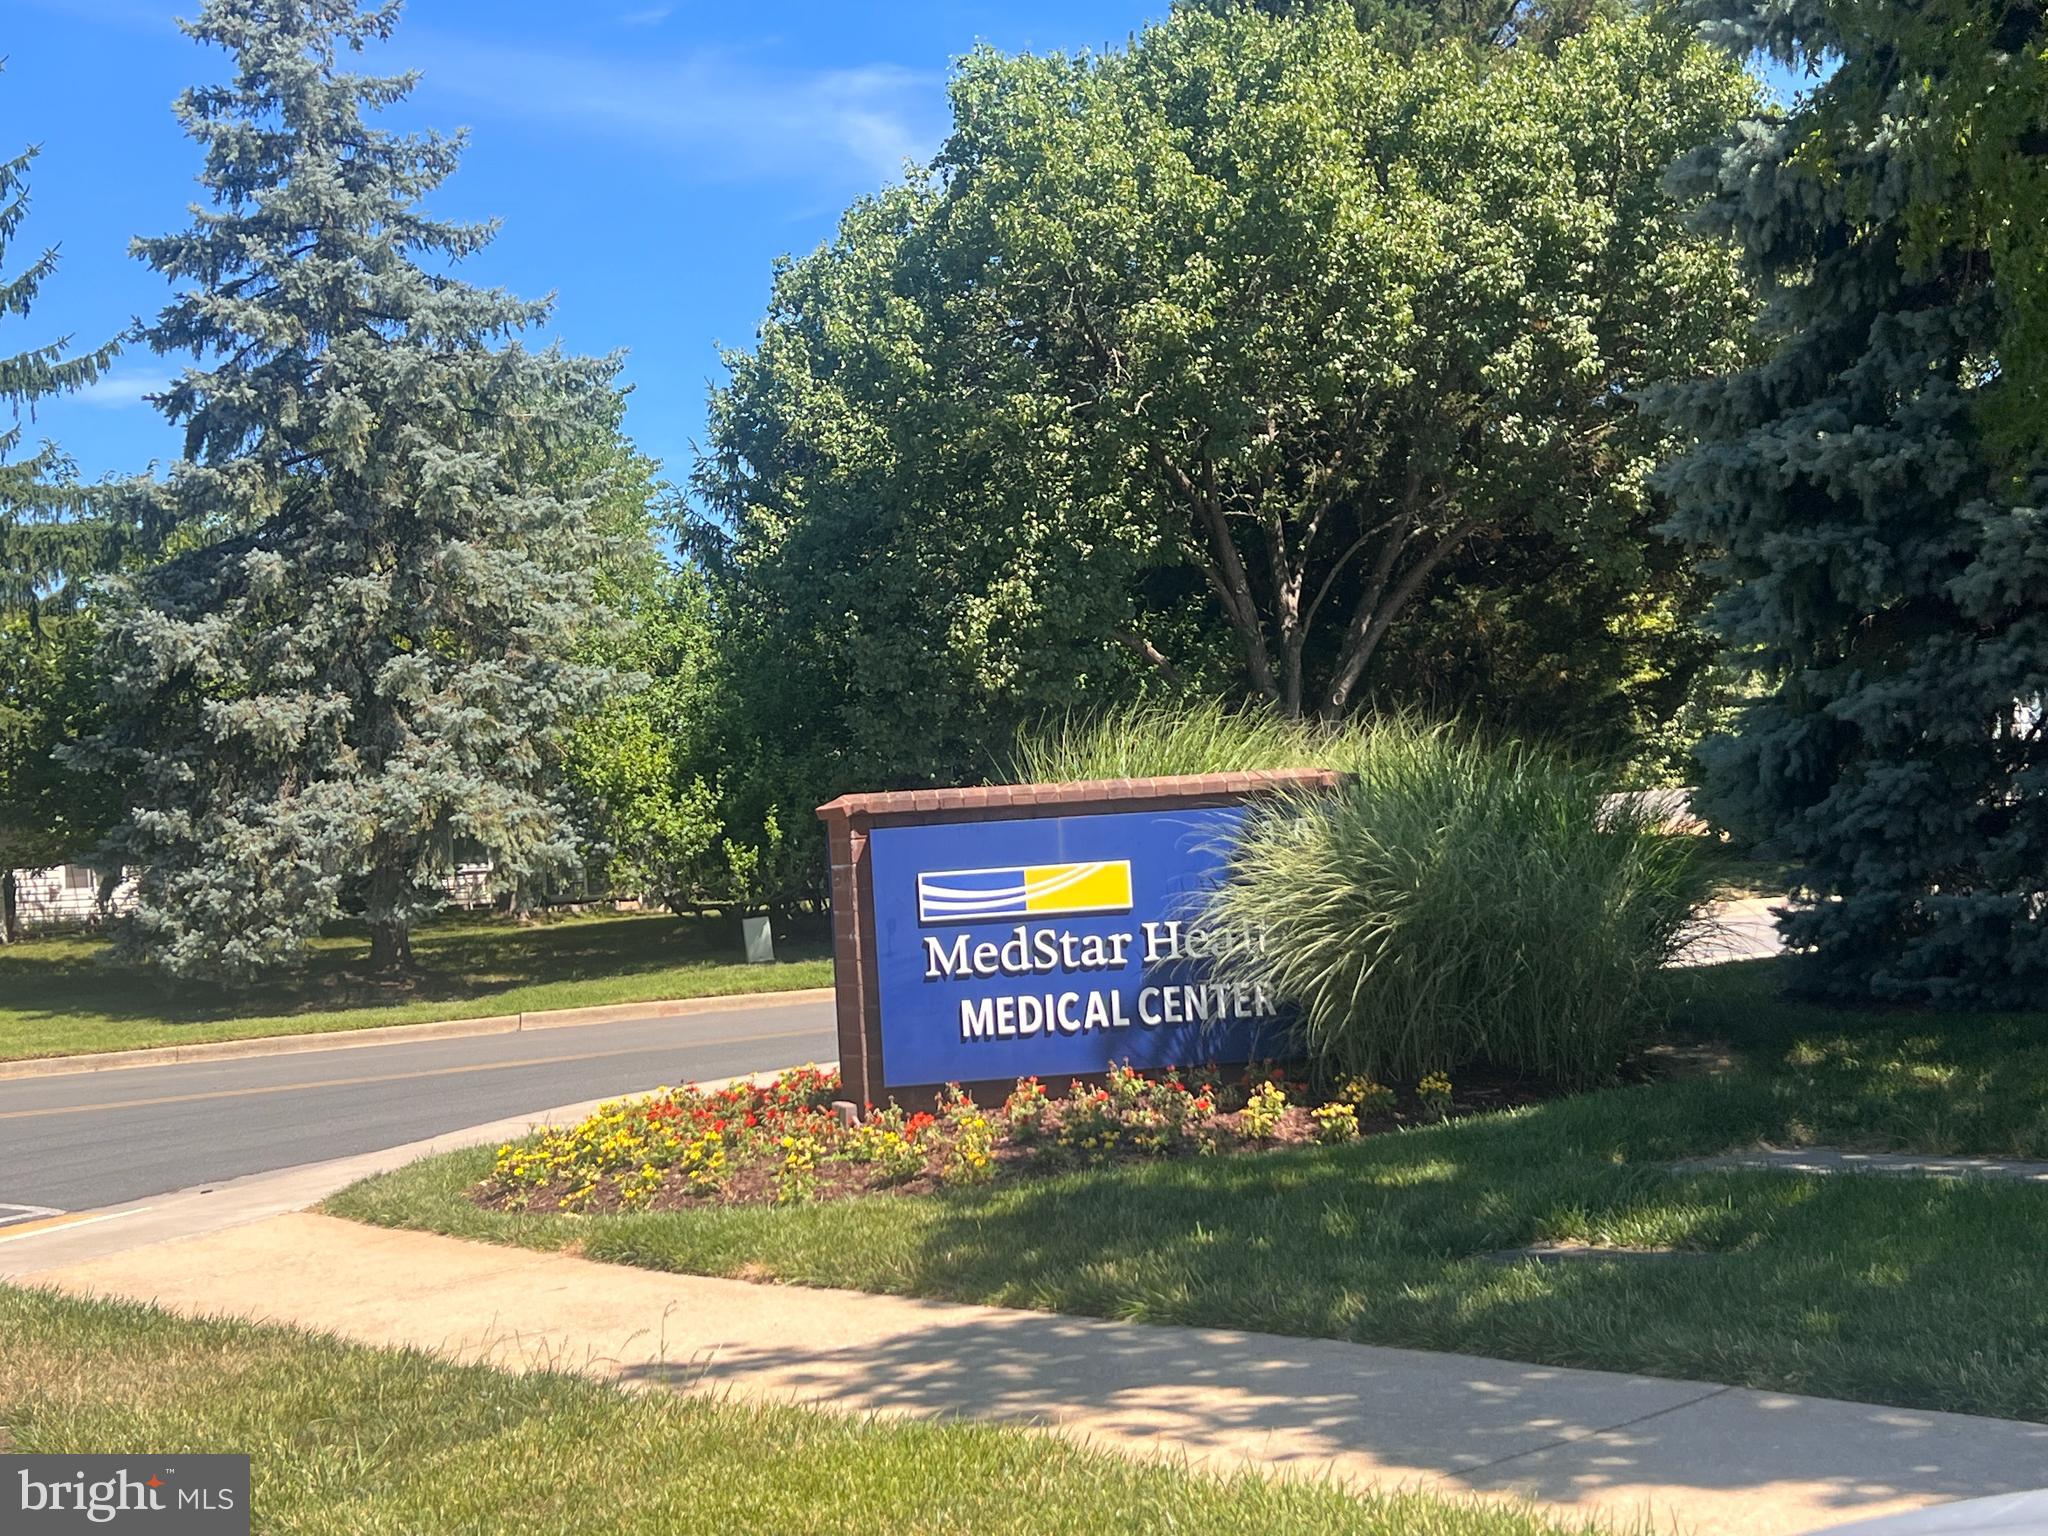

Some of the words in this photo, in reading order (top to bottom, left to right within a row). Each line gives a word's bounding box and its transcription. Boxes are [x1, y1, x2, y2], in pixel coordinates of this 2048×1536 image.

[924, 925, 1132, 976] MedStar
[961, 989, 1130, 1037] MEDICAL
[1138, 981, 1277, 1026] CENTER
